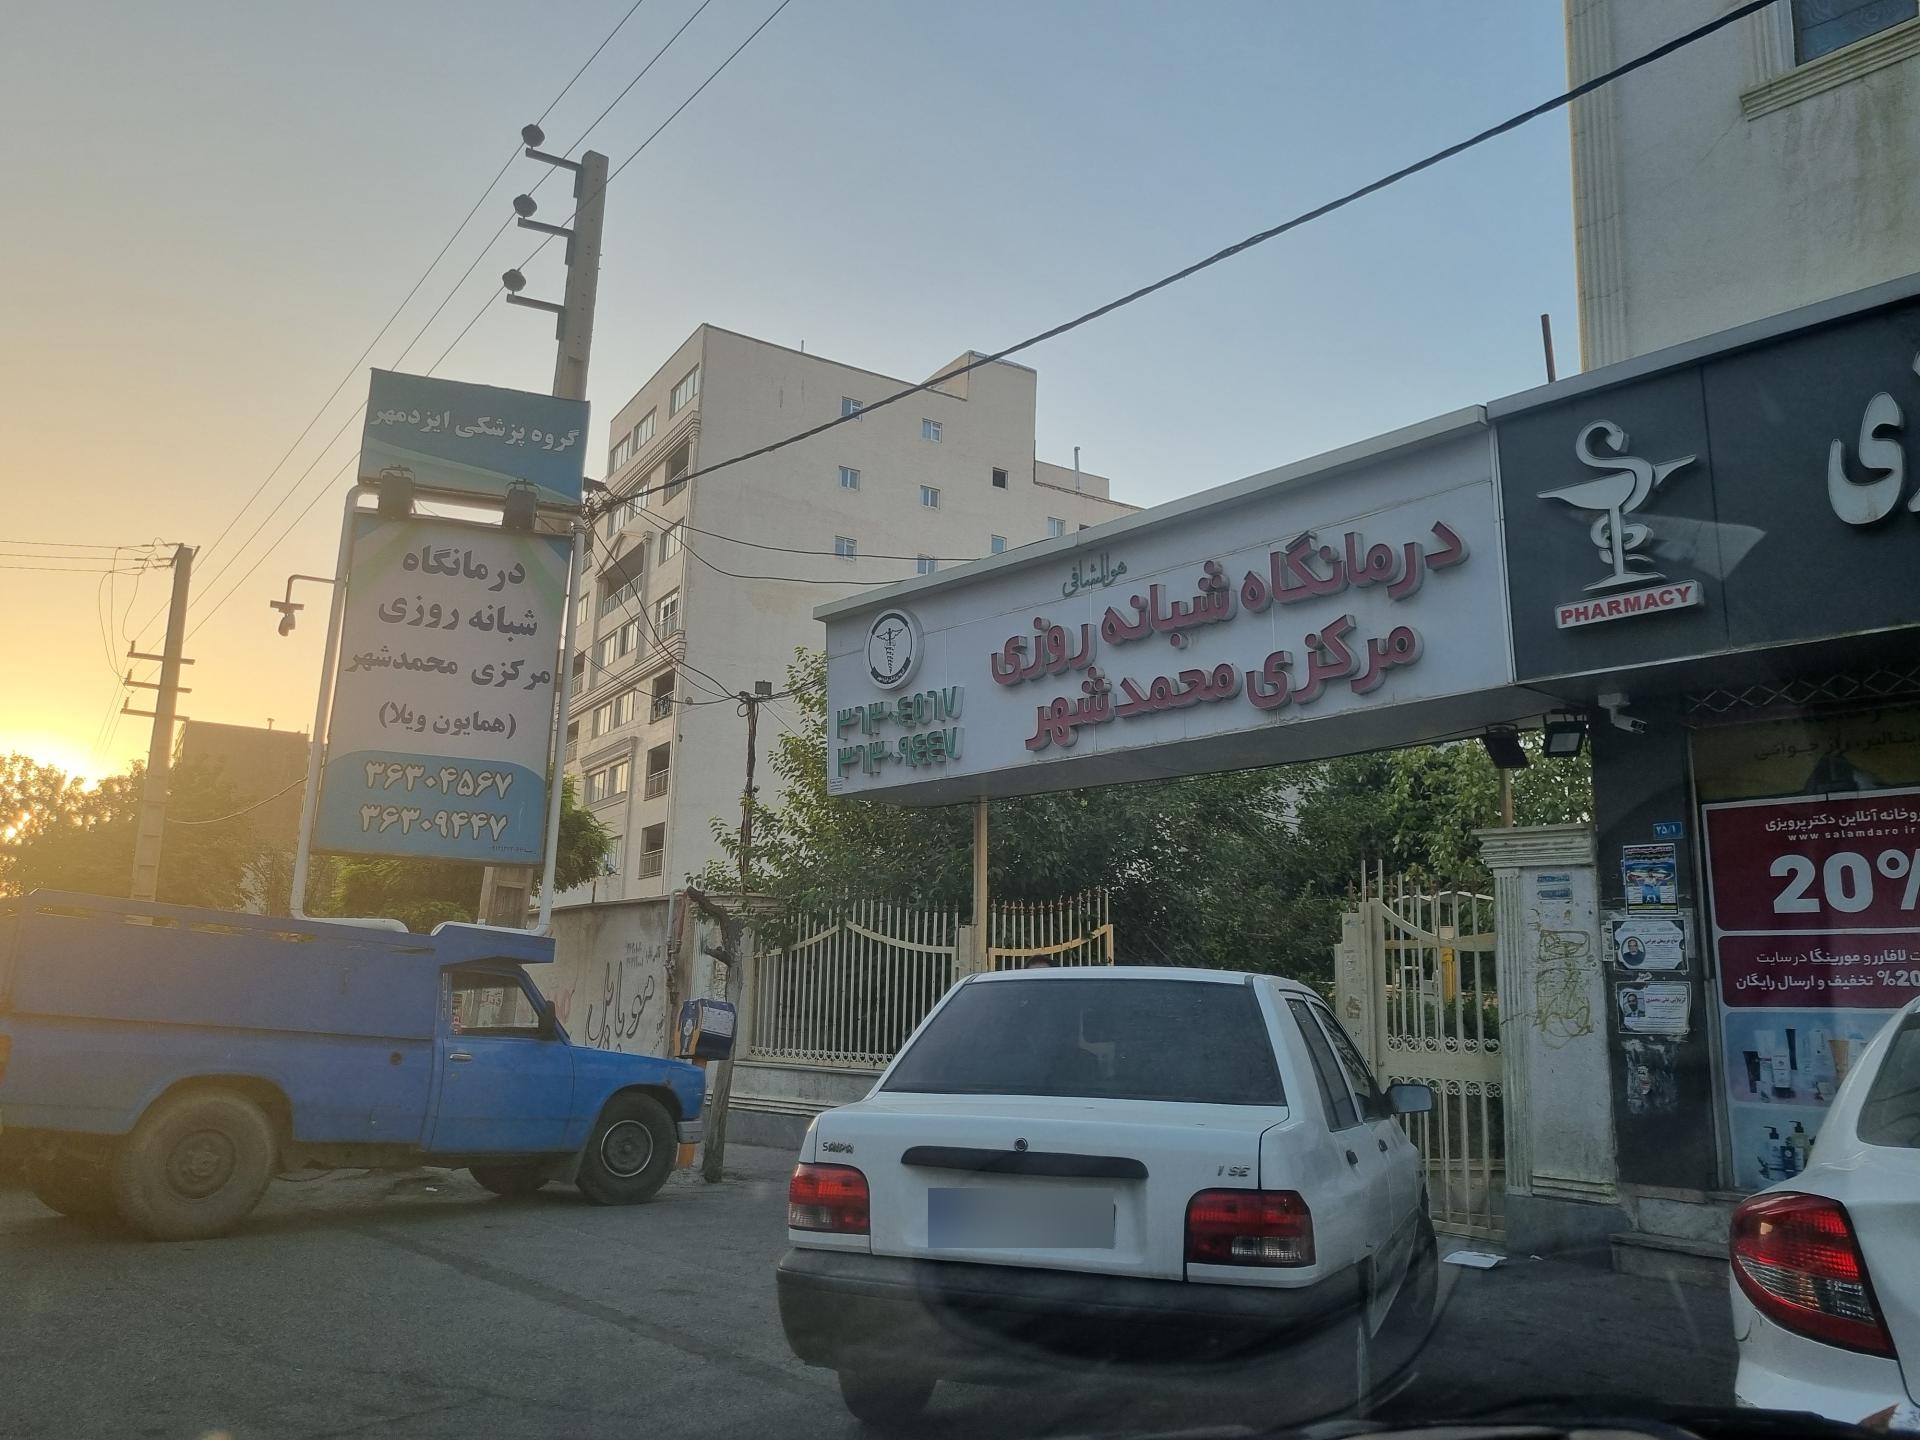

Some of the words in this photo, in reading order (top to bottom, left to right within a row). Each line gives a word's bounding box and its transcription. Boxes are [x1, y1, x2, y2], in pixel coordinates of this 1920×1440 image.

[455, 416, 526, 448] پزشکی
[529, 428, 580, 452] گروه
[402, 545, 527, 592] درمانگاه
[1240, 520, 1470, 614] درمانگاه
[378, 595, 460, 631] روزی
[1101, 560, 1237, 650] شبانه
[1560, 585, 1692, 626] PHARMACY
[467, 604, 539, 643] شبانه
[990, 616, 1097, 687] روزی
[1245, 614, 1424, 712] مرکزی
[471, 659, 551, 691] مرکزی
[1838, 808, 1878, 827] آنلاین
[1735, 972, 1775, 991] رایگان
[1777, 975, 1815, 990] ارسال
[1827, 973, 1874, 990] تخفیف
